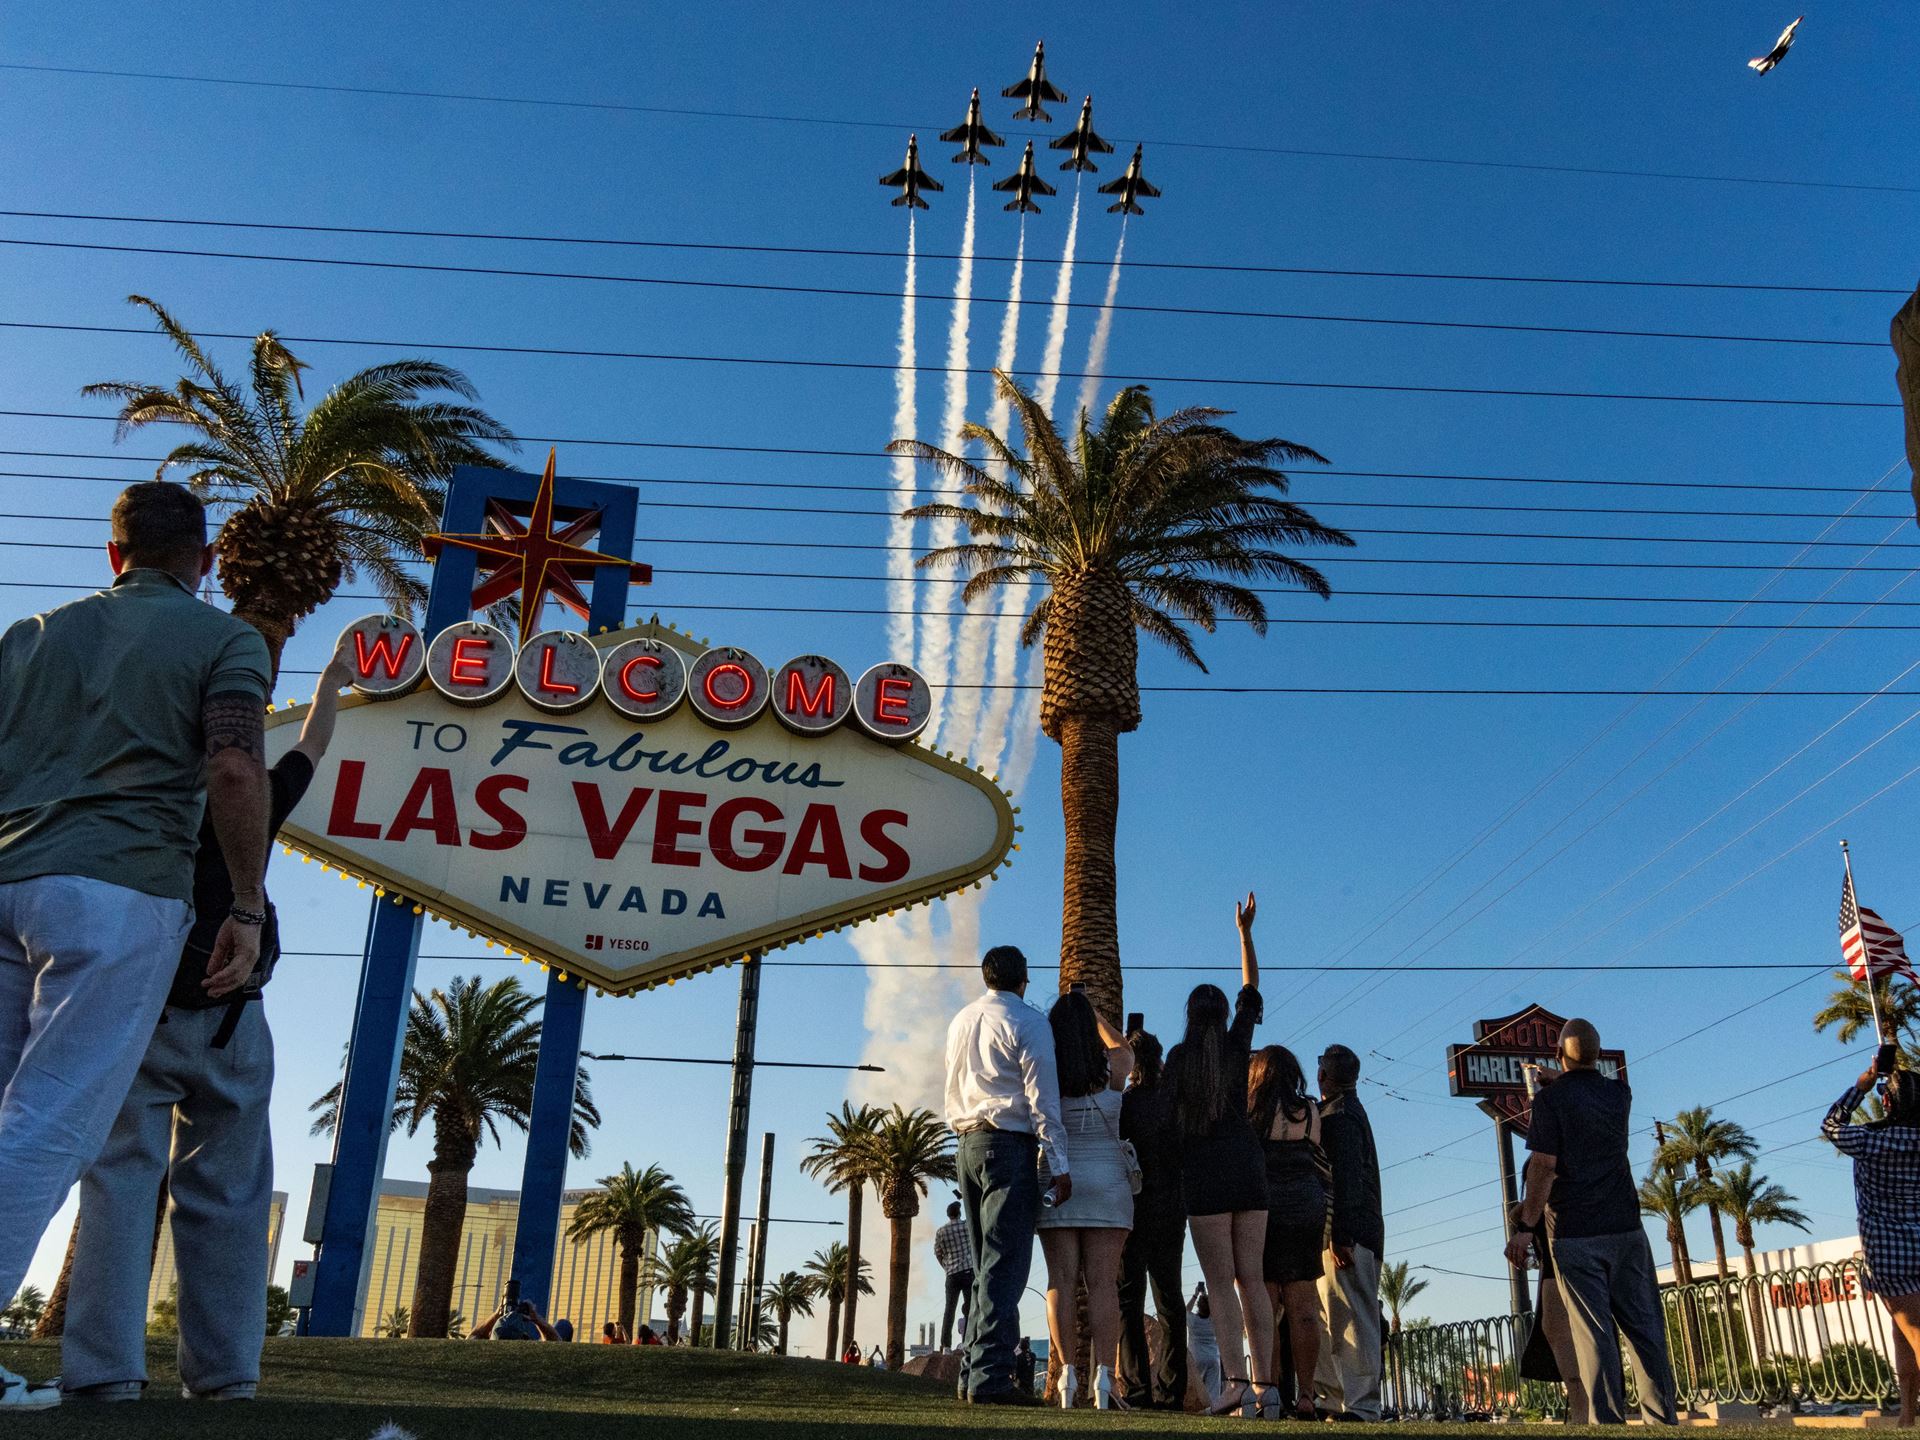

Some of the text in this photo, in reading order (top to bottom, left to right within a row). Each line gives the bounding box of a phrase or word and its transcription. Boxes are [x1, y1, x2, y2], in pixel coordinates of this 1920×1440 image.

[353, 630, 914, 726] WELCOME
[406, 719, 844, 787] TO Fabulous
[327, 760, 911, 883] LAS VEGAS
[500, 875, 726, 919] NEVADA
[609, 938, 649, 951] YESCO
[1499, 1018, 1560, 1048] MOTO
